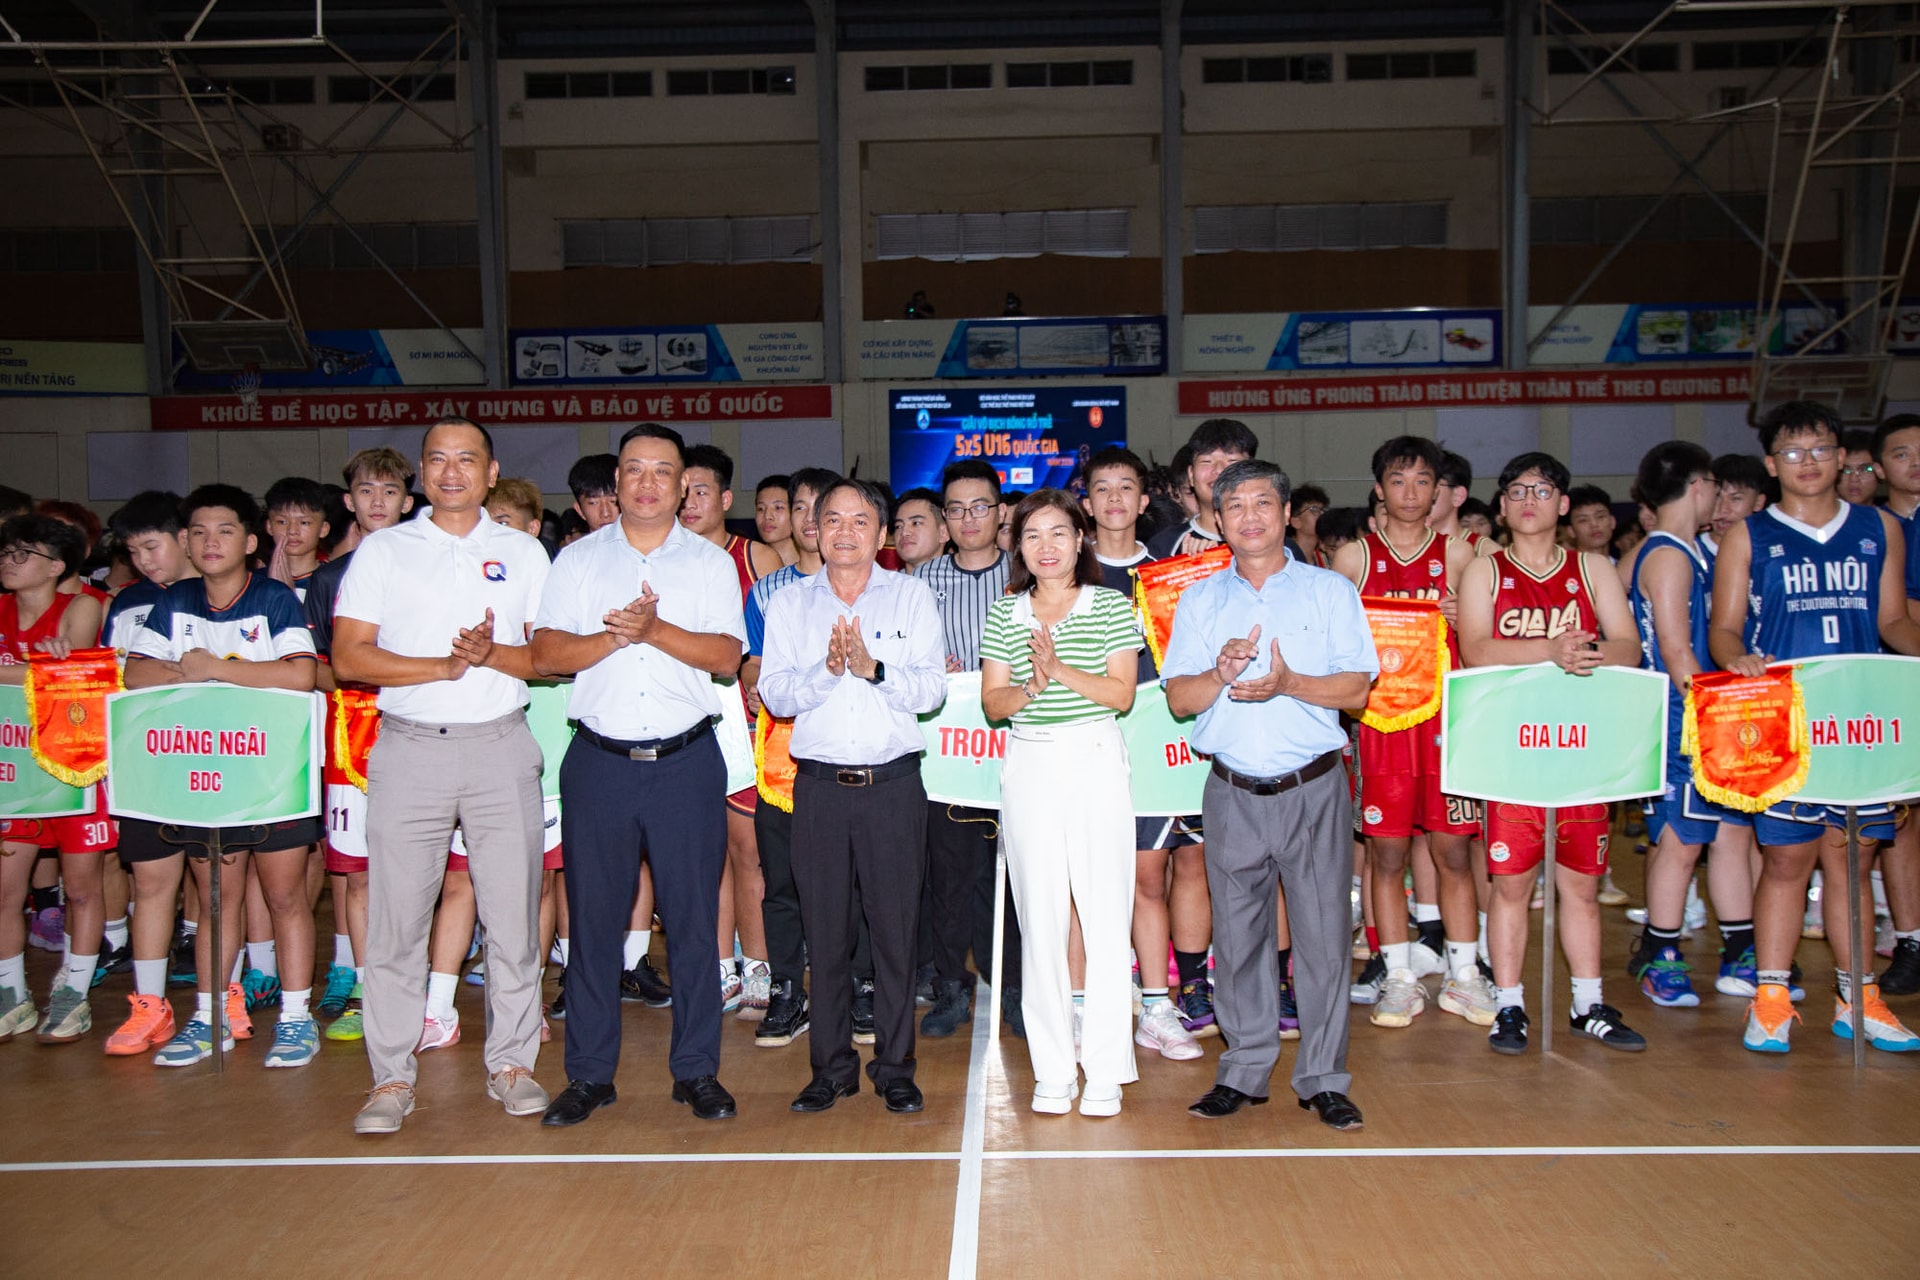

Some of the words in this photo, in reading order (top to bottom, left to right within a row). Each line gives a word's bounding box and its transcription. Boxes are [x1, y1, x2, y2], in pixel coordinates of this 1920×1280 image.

[1273, 384, 1311, 406] ỨNG
[1314, 385, 1374, 405] PHONG
[1466, 378, 1521, 402] LUYỆN
[1525, 377, 1571, 398] THÂN
[1575, 374, 1608, 398] THỂ
[1612, 379, 1655, 397] THEO
[1660, 377, 1721, 397] GƯƠNG
[272, 398, 302, 422] ĐỂ
[310, 403, 358, 423] HỌC
[365, 400, 417, 422] TẬP,
[425, 398, 470, 418] XÂY
[478, 399, 544, 420] DỰNG
[551, 395, 583, 416] VÀ
[590, 394, 638, 415] BẢO
[645, 394, 674, 418] VỆ
[681, 392, 711, 414] TỔ
[719, 391, 784, 415] QUỐC
[983, 432, 1011, 456] U16
[1012, 434, 1040, 458] QUỐC
[1040, 438, 1060, 455] GIA
[1782, 556, 1818, 595] HÀ
[1824, 555, 1868, 596] NỘI
[1786, 599, 1801, 612] THE
[1801, 597, 1838, 611] CULTURAL
[1498, 607, 1547, 638] GIA
[219, 726, 267, 757] NGÃI
[1518, 723, 1551, 750] GIA
[1557, 723, 1587, 750] LAI
[1811, 714, 1841, 746] HÀ
[1847, 713, 1883, 751] NỘI
[1889, 718, 1902, 745] 1
[1164, 736, 1193, 768] ĐÀ
[190, 770, 222, 793] BDC
[331, 806, 350, 831] 11
[1446, 797, 1475, 826] 20
[84, 820, 109, 846] 30
[1597, 834, 1609, 865] 7
